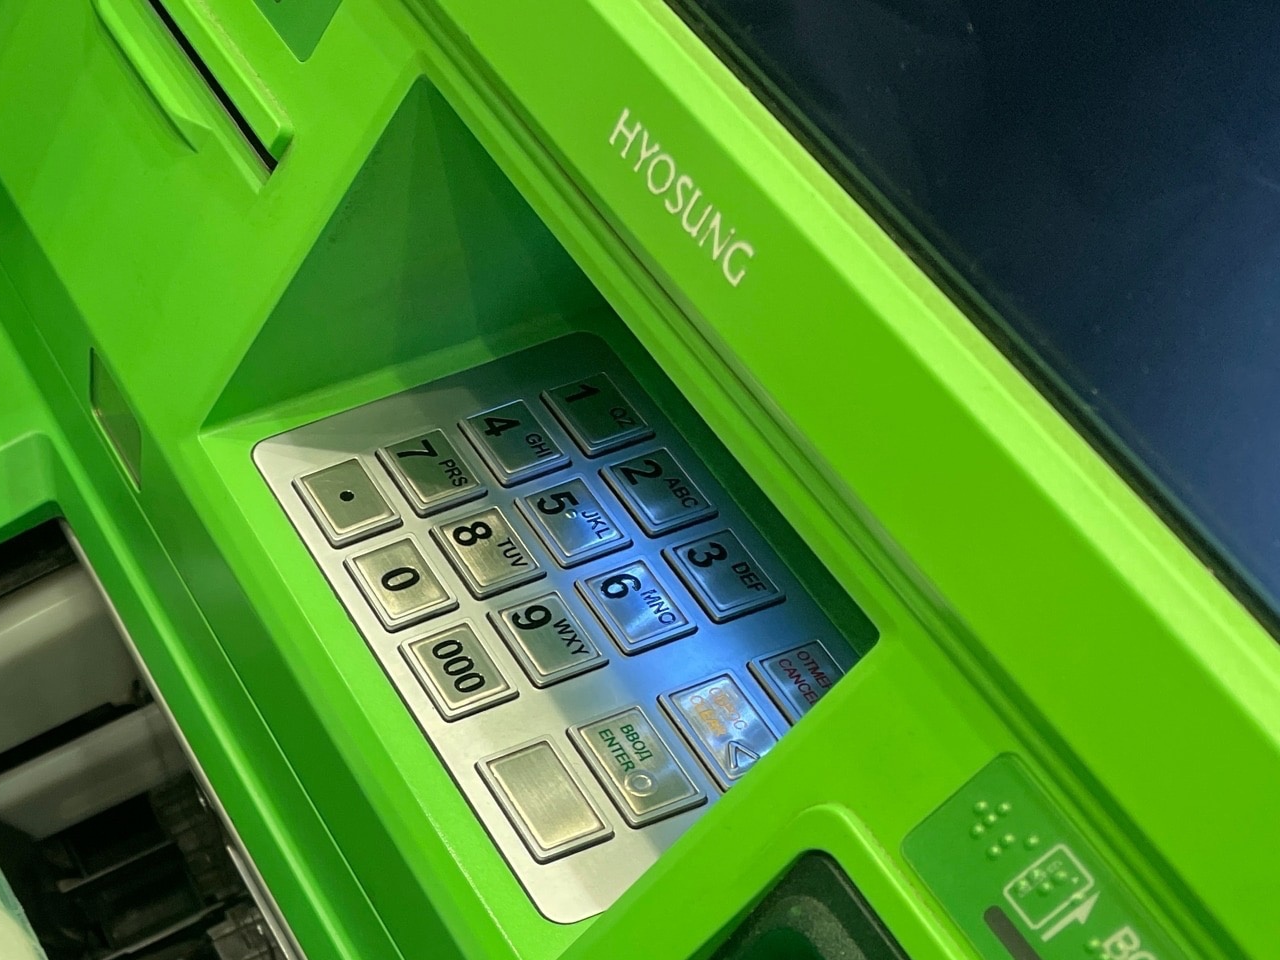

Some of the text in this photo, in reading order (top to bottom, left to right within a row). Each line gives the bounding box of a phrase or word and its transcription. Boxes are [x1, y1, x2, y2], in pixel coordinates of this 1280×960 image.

[609, 107, 754, 287] HYOSUNG
[565, 383, 636, 427] 1 QZ
[483, 416, 553, 458] 4 GHI
[397, 439, 468, 488] 7 PRS
[620, 459, 699, 508] 2 ABC
[537, 491, 607, 539] 5 JKL
[452, 521, 528, 567] 8 TUV
[687, 542, 767, 593] 3 DEF
[381, 566, 420, 591] 0
[600, 574, 677, 626] 6 MNO
[511, 604, 590, 656] 9 WXY
[431, 639, 485, 693] 000
[598, 728, 636, 773] ENTER
[620, 723, 653, 762] ВВОД
